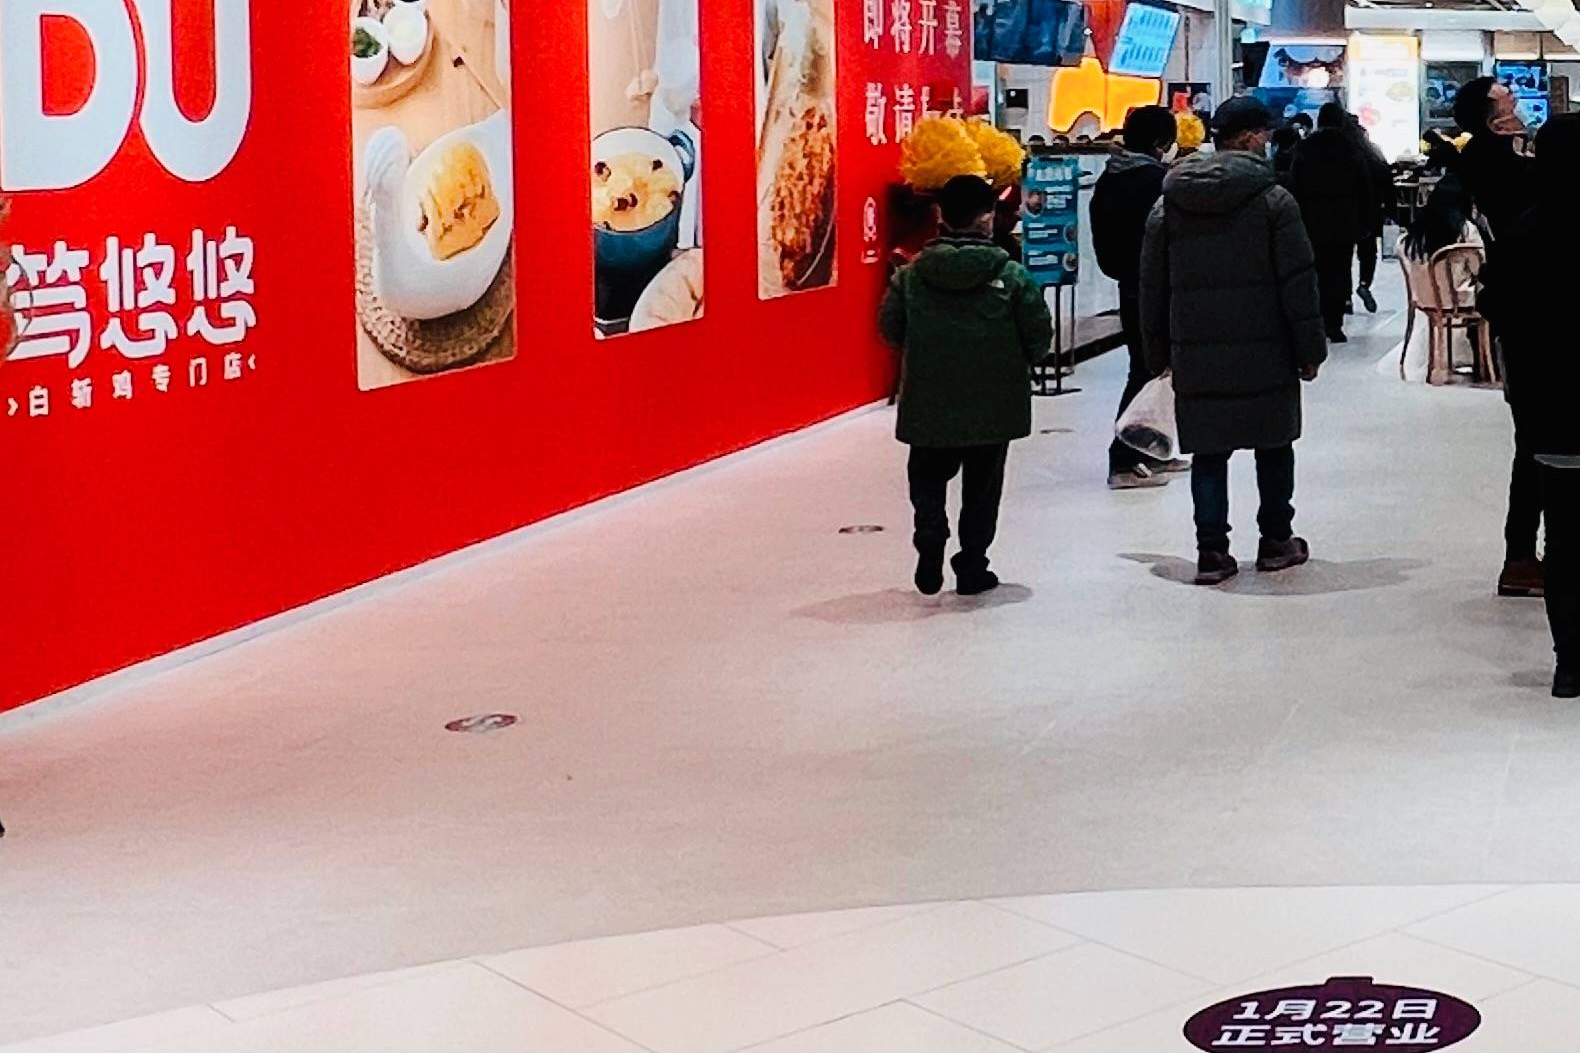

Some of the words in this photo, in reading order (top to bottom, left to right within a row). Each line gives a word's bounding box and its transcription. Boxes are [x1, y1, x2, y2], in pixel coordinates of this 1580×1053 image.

[6, 225, 257, 369] 笃悠悠
[1231, 998, 1438, 1021] 1月22日
[1210, 1022, 1441, 1047] 正式营业
